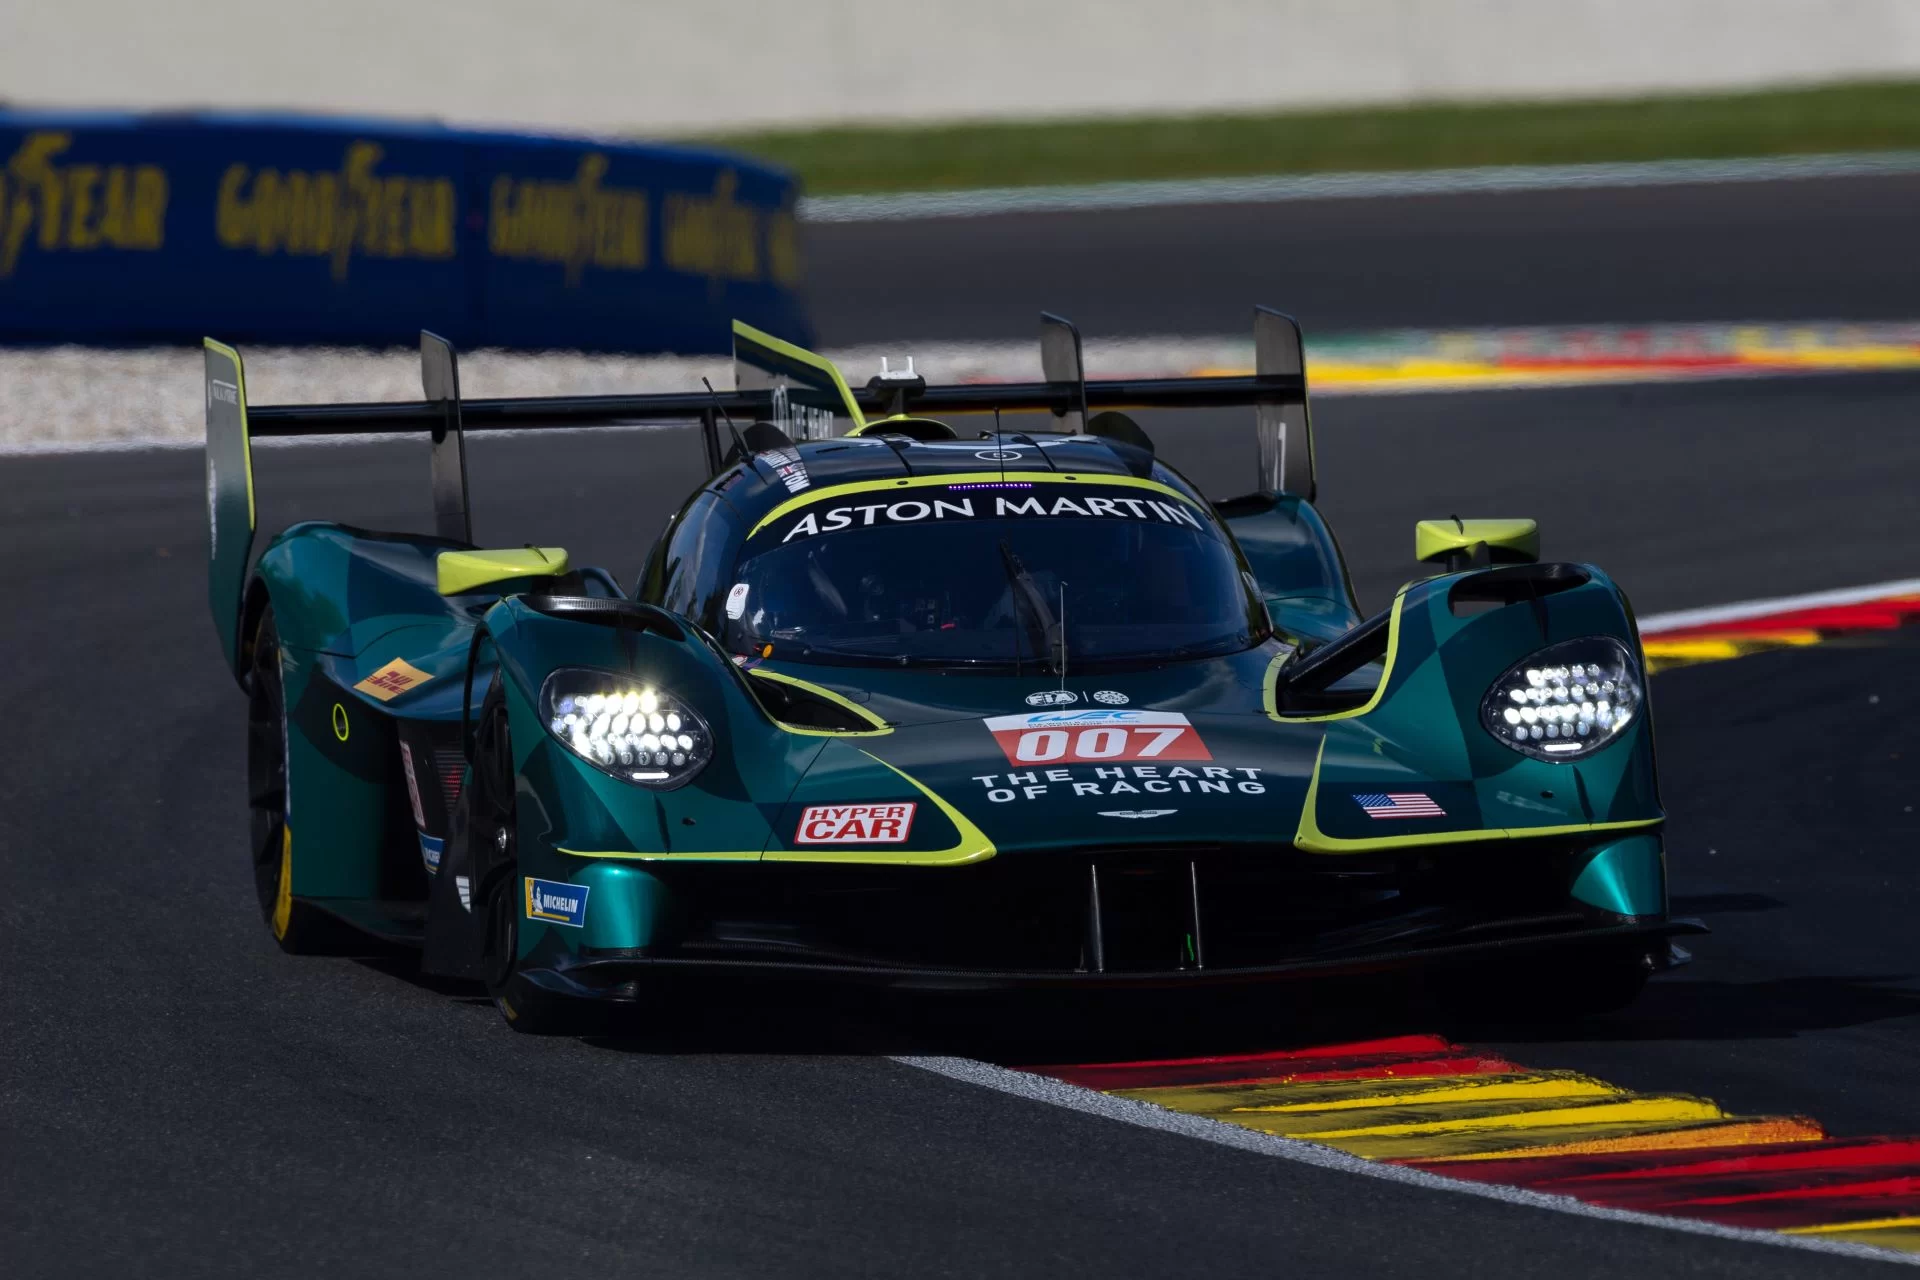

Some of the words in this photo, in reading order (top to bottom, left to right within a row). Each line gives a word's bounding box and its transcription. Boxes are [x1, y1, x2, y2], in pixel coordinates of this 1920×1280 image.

[782, 499, 975, 543] ASTON
[996, 496, 1204, 530] MARTIN
[1028, 692, 1076, 705] FIA
[1027, 710, 1143, 723] WEC
[1015, 727, 1186, 762] 007
[972, 769, 1074, 788] THE
[1094, 766, 1262, 780] HEART
[987, 785, 1048, 803] OF
[1072, 780, 1266, 796] RACING
[809, 806, 906, 820] HYPER
[805, 819, 902, 839] CAR
[543, 894, 579, 914] MICHELIN
